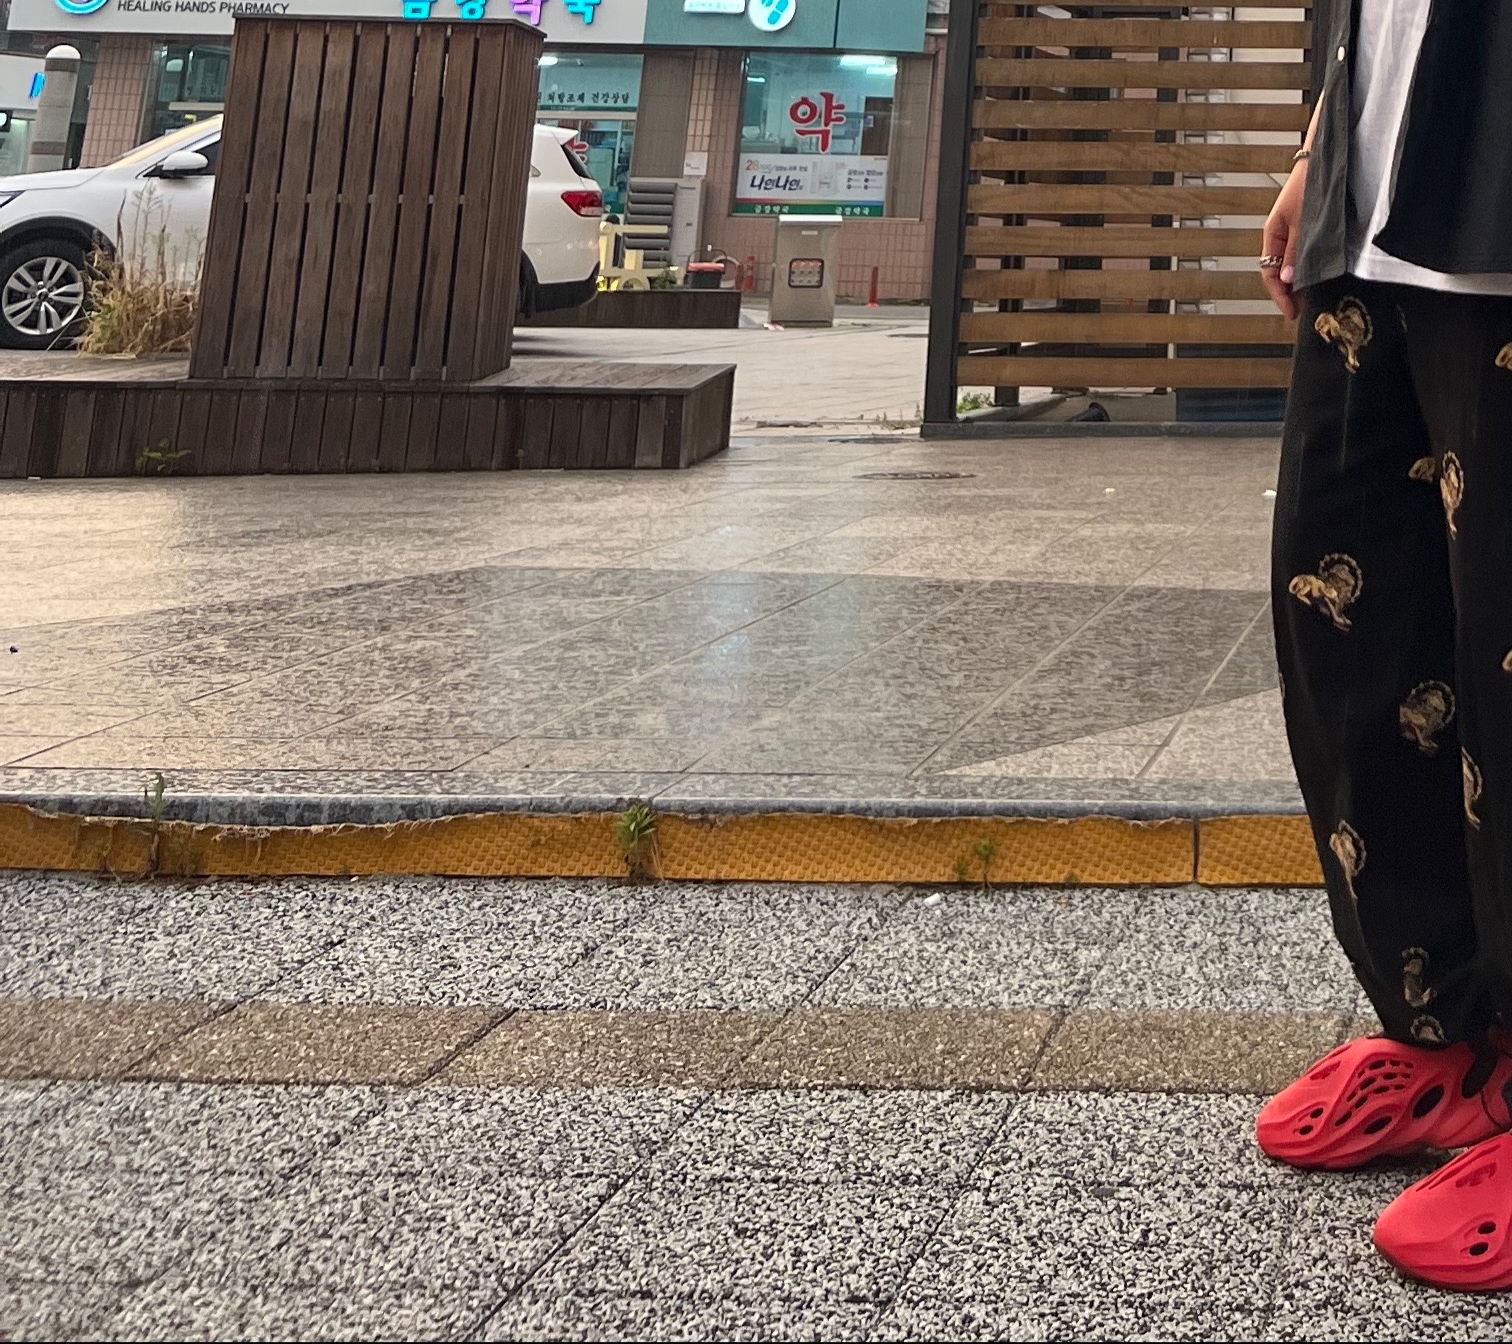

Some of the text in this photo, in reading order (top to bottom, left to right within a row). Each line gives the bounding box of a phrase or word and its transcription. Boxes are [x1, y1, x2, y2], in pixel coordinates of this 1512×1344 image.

[117, 0, 290, 15] HEALING HANDS PHARMACY
[789, 91, 846, 154] 약
